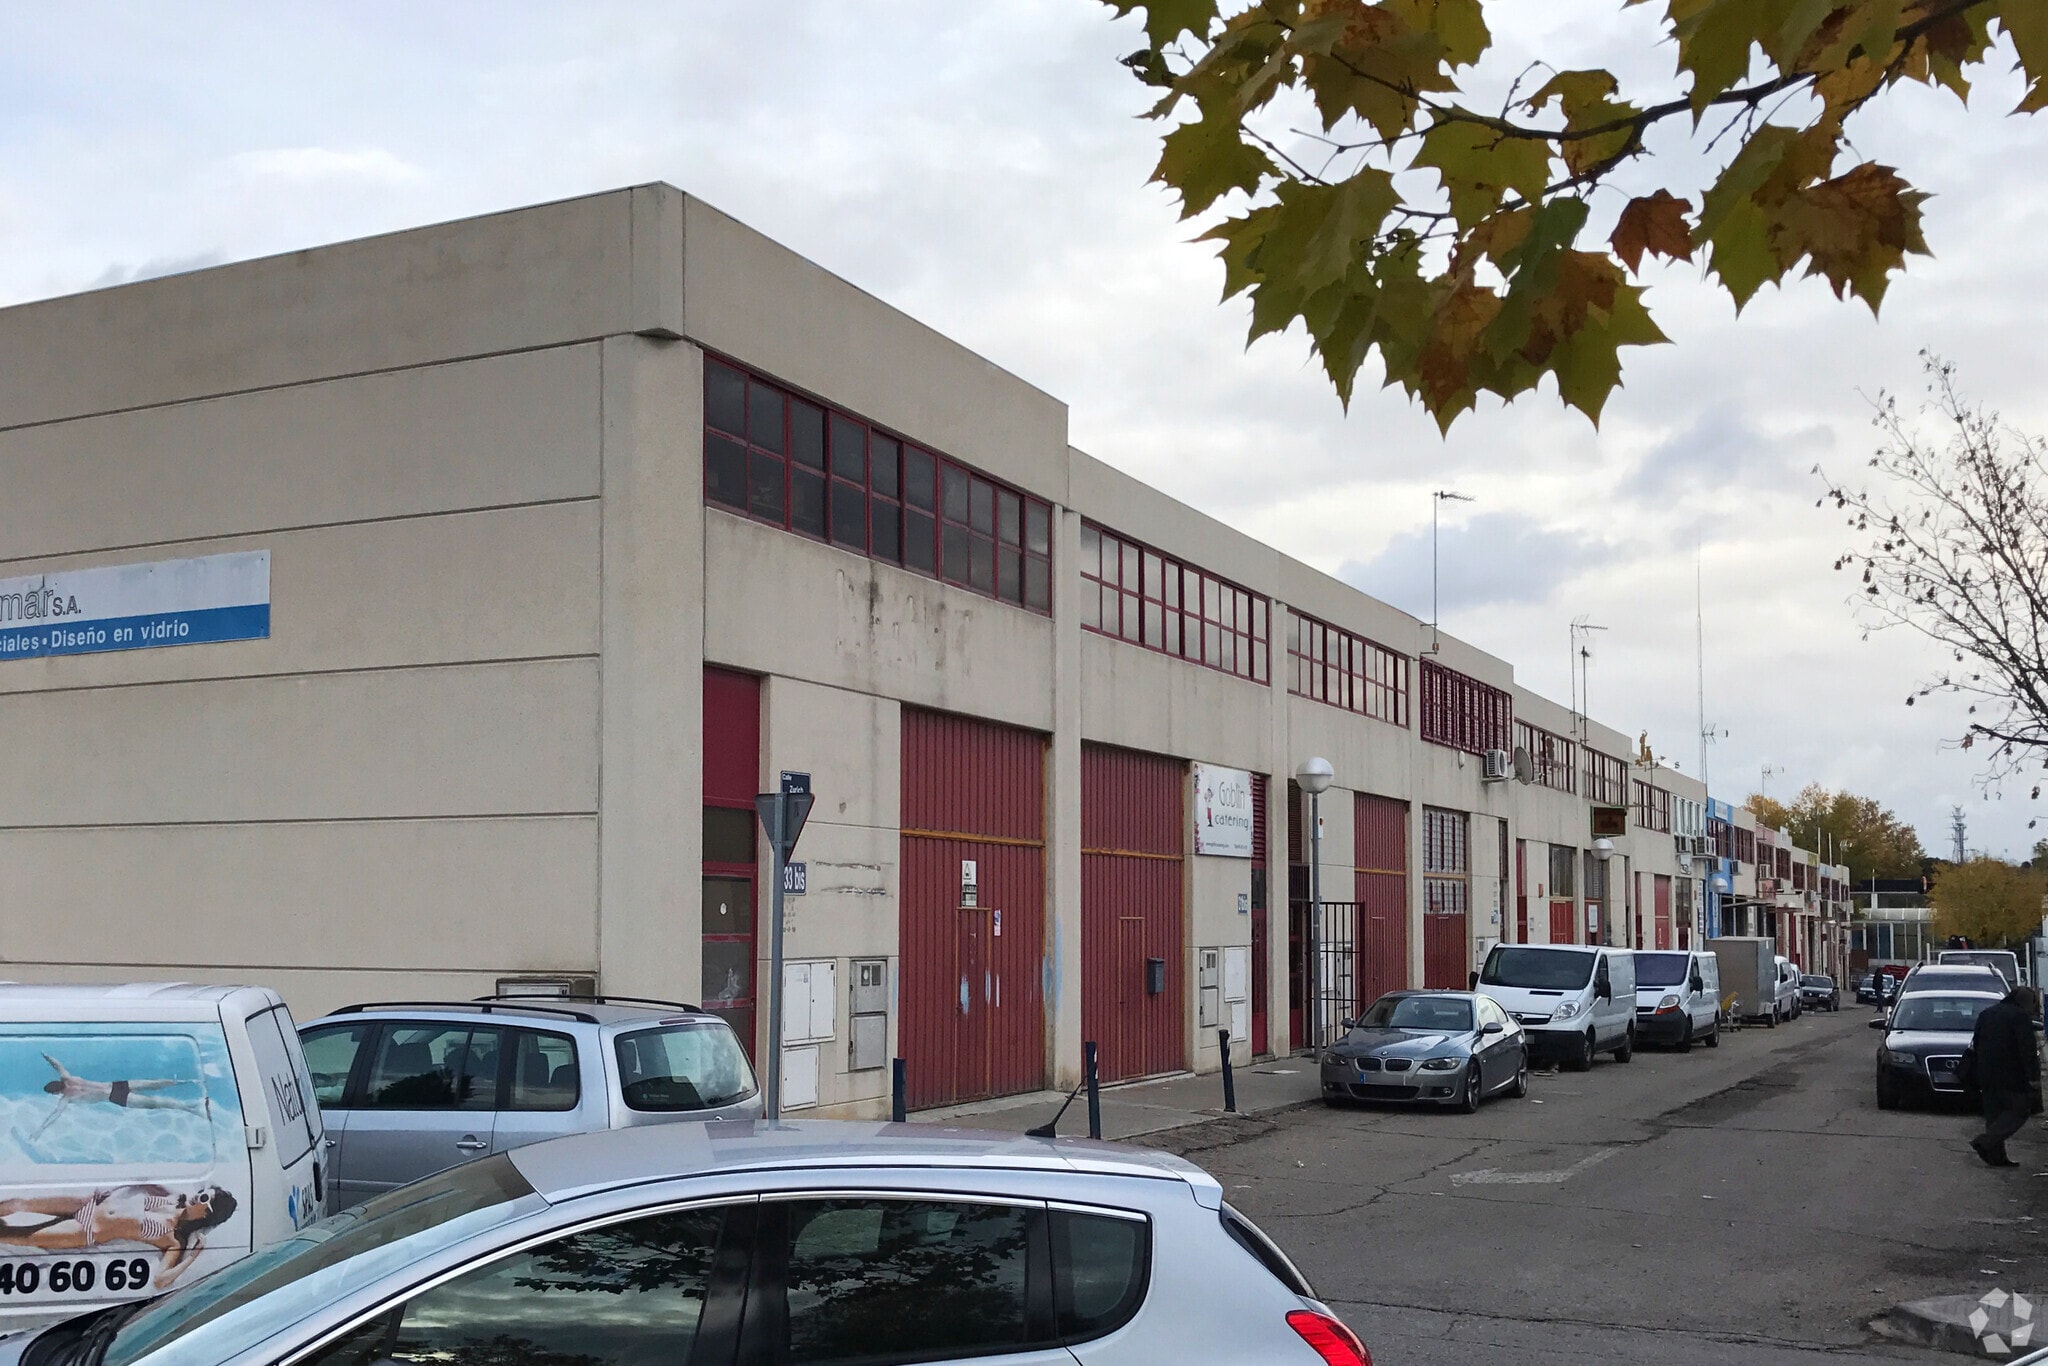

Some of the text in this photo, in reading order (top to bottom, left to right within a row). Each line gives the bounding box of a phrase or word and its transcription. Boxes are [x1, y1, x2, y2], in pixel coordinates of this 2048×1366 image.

[51, 627, 106, 648] Diseño
[114, 628, 132, 642] en
[141, 620, 189, 640] vidrio
[1219, 782, 1245, 809] Goblin
[1215, 813, 1249, 831] catering
[794, 866, 805, 890] bis
[0, 1258, 150, 1295] 40 60 69
